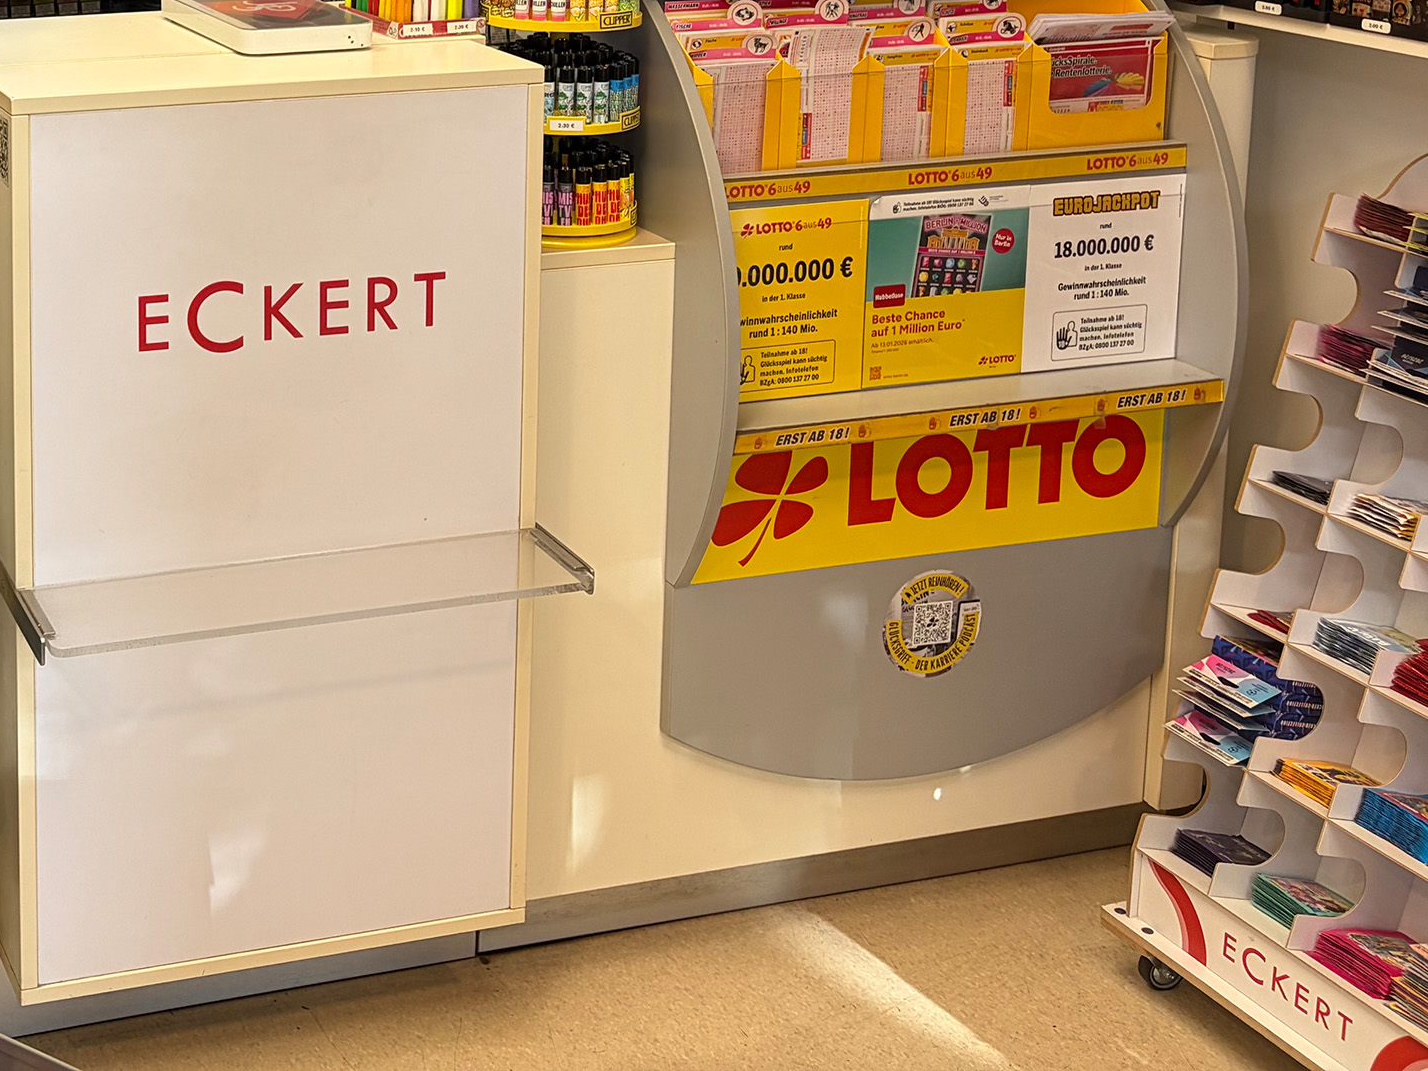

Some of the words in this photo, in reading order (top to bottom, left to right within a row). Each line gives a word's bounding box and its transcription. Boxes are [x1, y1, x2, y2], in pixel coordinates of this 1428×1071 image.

[1052, 190, 1160, 216] EUROJACKPOT
[1054, 236, 1141, 258] 18.000.000
[1144, 234, 1154, 251] €
[1058, 276, 1146, 292] Gewinnwahrscheinlichkeit
[138, 271, 447, 353] ECKERT
[872, 313, 902, 325] Beste
[905, 309, 945, 321] Chance
[871, 326, 889, 338] auf
[892, 325, 896, 336] 1
[899, 322, 935, 335] Million
[1117, 393, 1147, 408] ERST
[1147, 392, 1164, 406] AB
[1167, 390, 1186, 402] 18!
[847, 414, 1147, 527] LOTTO
[1222, 931, 1354, 1041] ECKERT
